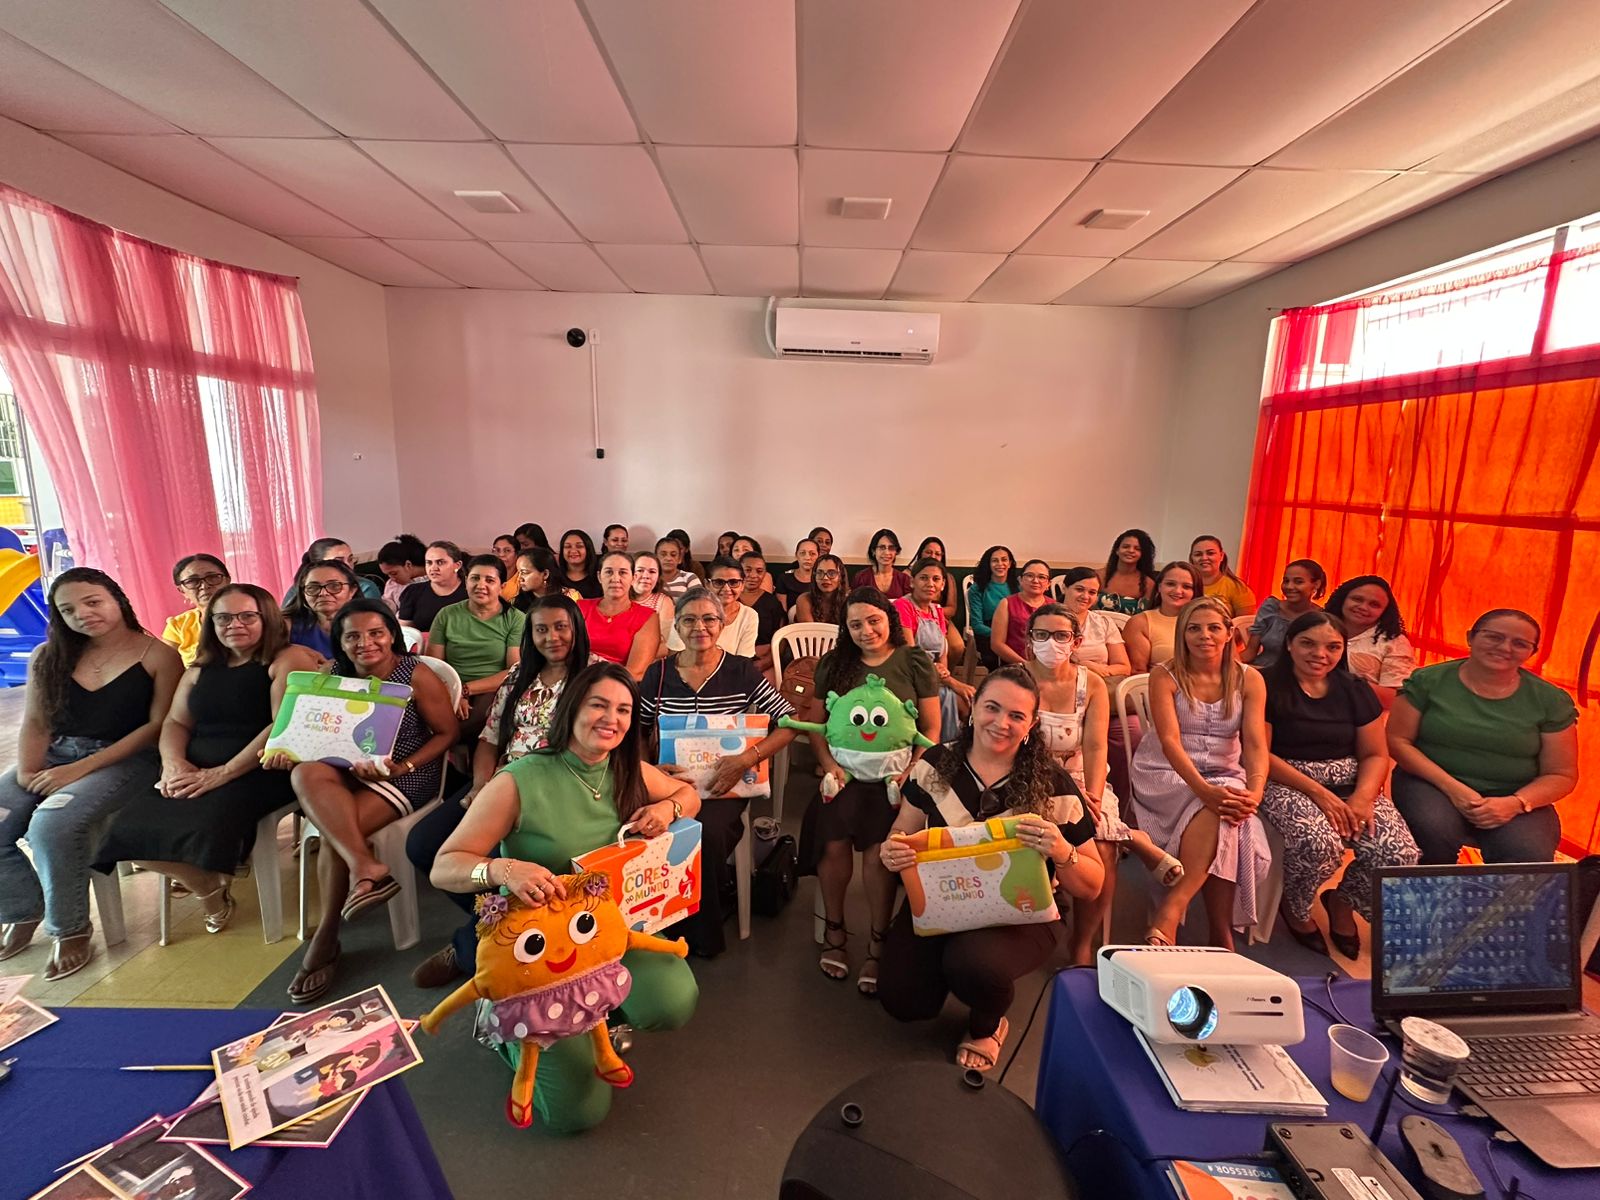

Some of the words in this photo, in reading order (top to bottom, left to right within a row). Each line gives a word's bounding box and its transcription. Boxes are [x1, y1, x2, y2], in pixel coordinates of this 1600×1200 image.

[305, 711, 343, 725] CORES
[689, 751, 721, 763] CORES
[624, 863, 669, 893] CORES
[939, 876, 982, 893] CORES
[635, 879, 669, 902] MUNDO
[682, 883, 692, 899] 4
[951, 889, 984, 902] MUNDO
[1022, 903, 1032, 918] 5
[1215, 1165, 1273, 1179] PROFESSOR
